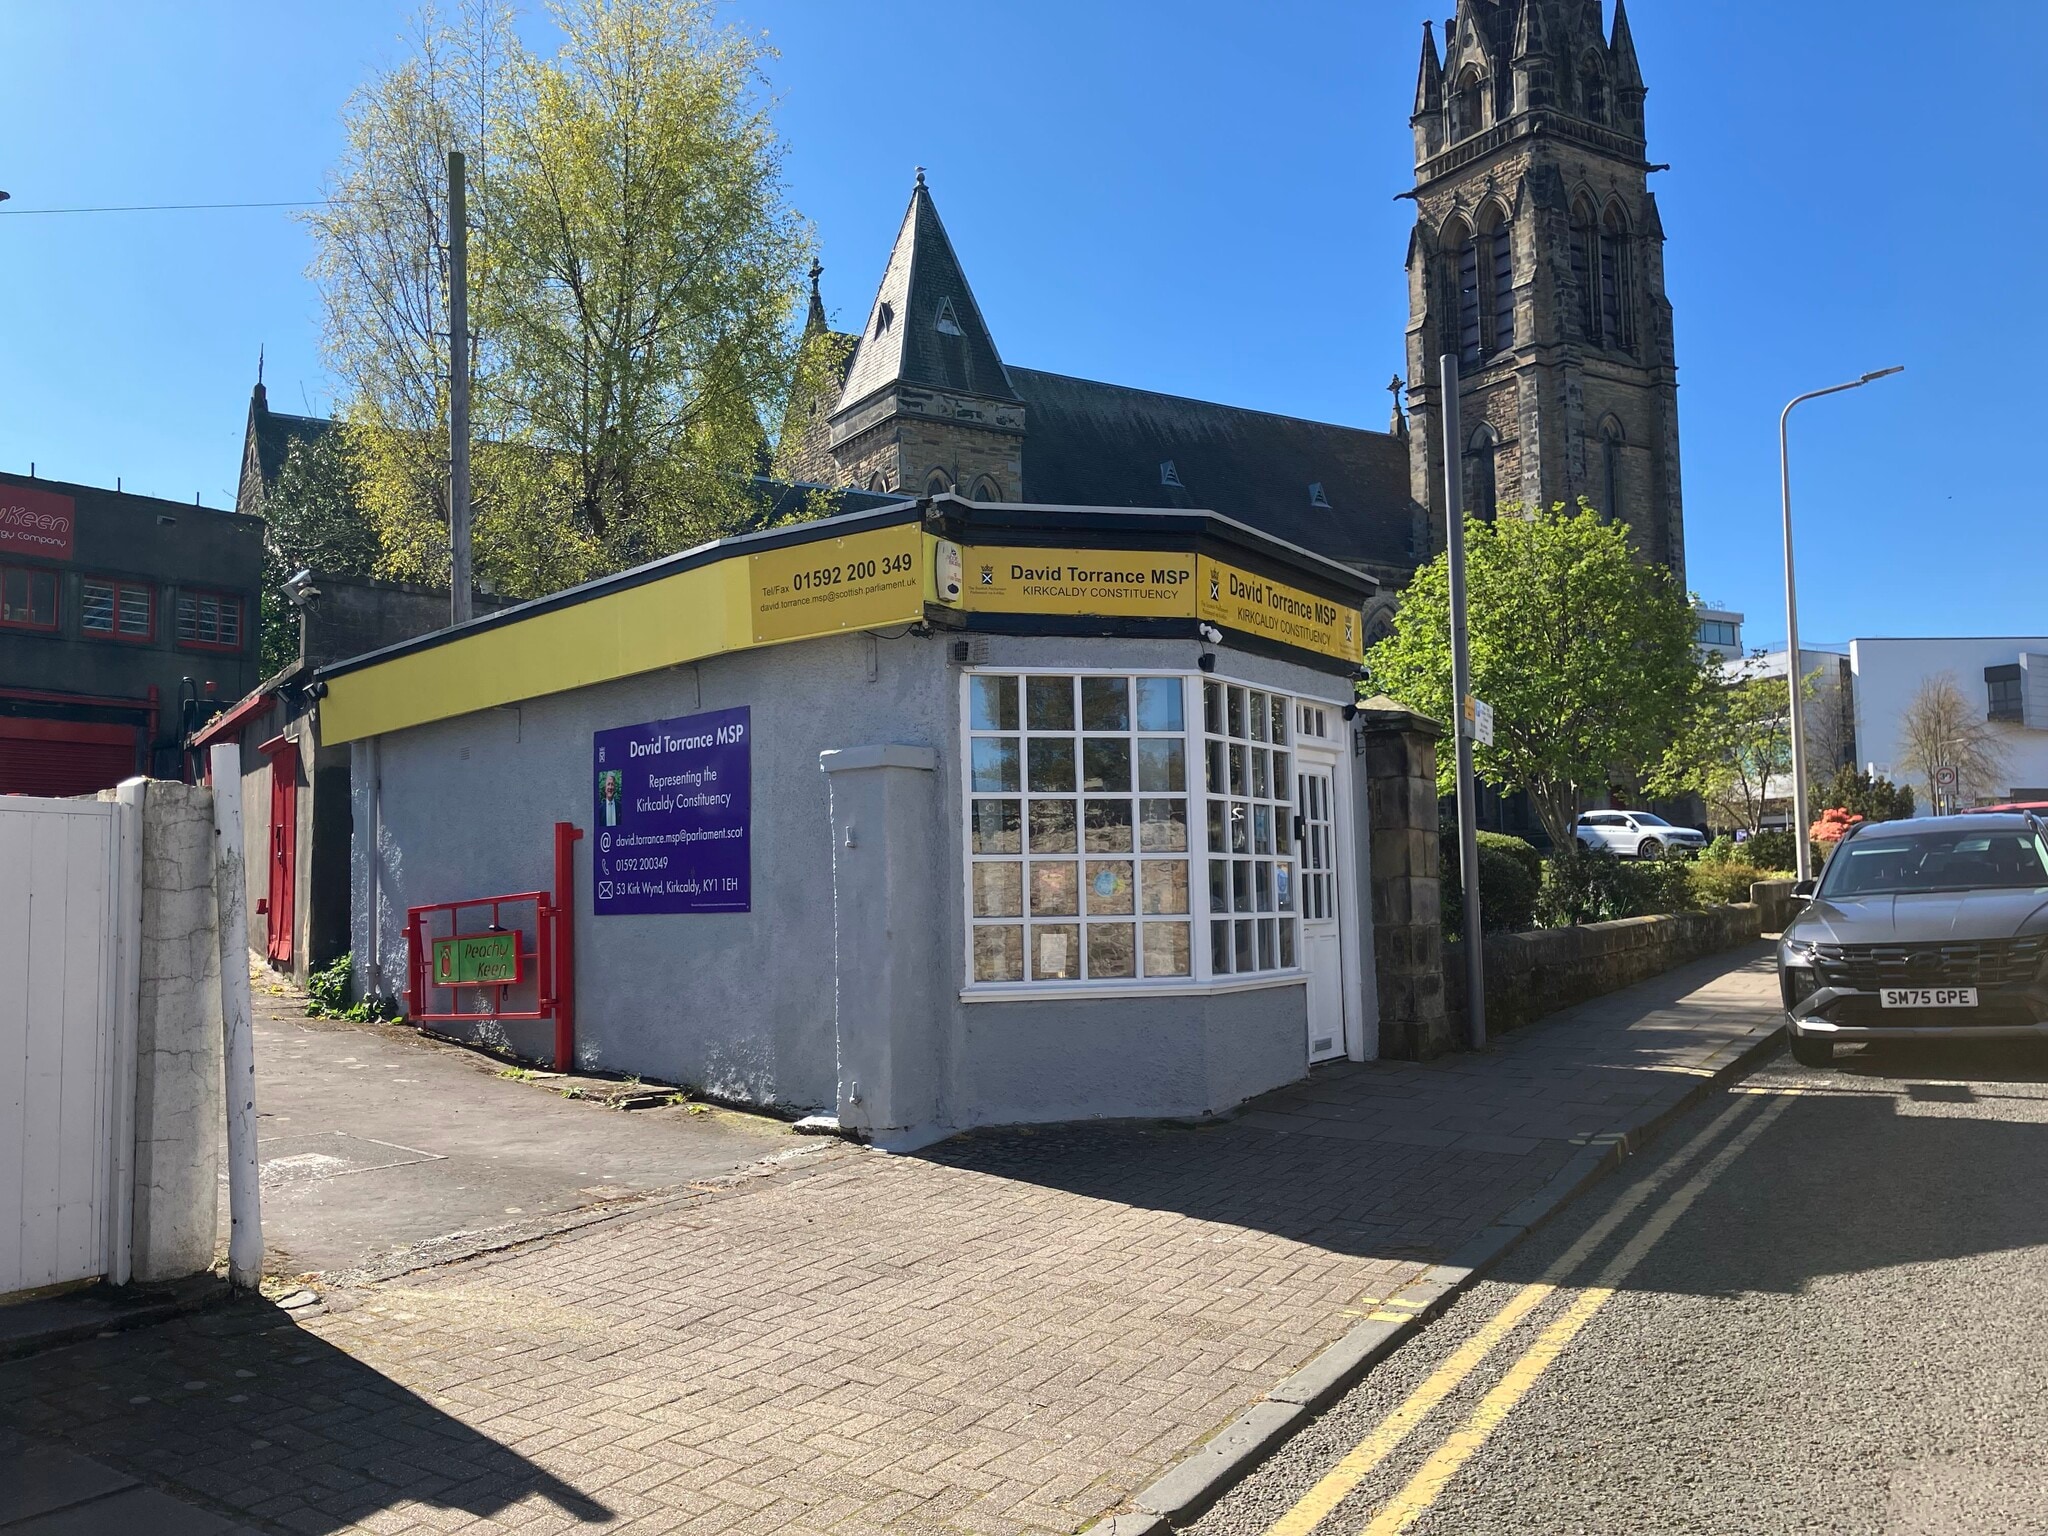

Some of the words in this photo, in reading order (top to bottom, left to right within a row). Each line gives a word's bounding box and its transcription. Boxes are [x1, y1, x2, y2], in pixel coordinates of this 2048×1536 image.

[17, 531, 67, 548] Company
[762, 584, 790, 597] Tel/Fax
[793, 566, 841, 591] 01592
[847, 560, 876, 581] 200
[882, 553, 912, 575] 349
[1011, 565, 1061, 581] David
[1067, 567, 1145, 583] Torrance
[1151, 569, 1190, 585] MSP
[1023, 586, 1087, 598] KIRKCALDY
[1090, 588, 1179, 599] CONSTITUENCY
[1230, 573, 1263, 605] David
[1265, 585, 1312, 620] Torrance
[1315, 602, 1336, 627] MSP
[1237, 606, 1279, 630] KIRKCALDY
[1280, 619, 1331, 646] CONSTITUENCY
[630, 735, 662, 758] David
[664, 732, 713, 753] Torrance
[716, 724, 744, 746] MSP
[649, 769, 702, 791] Representing
[704, 766, 717, 782] the
[636, 794, 675, 813] Kirkcaldy
[676, 792, 731, 810] Constituency
[616, 826, 743, 848] david.torrance.msp@parliament.scot
[616, 857, 638, 872] 01592
[639, 856, 669, 871] 200349
[616, 882, 626, 895] 53
[627, 881, 641, 895] Kirk
[641, 880, 665, 897] Wynd,
[666, 879, 701, 896] Kirkcaldy,
[703, 878, 719, 892] KY1
[722, 878, 738, 891] 1EH
[464, 941, 509, 961] Peachy
[477, 962, 507, 978] Keen
[1887, 990, 1932, 1005] SM75
[1936, 990, 1970, 1004] GPE
